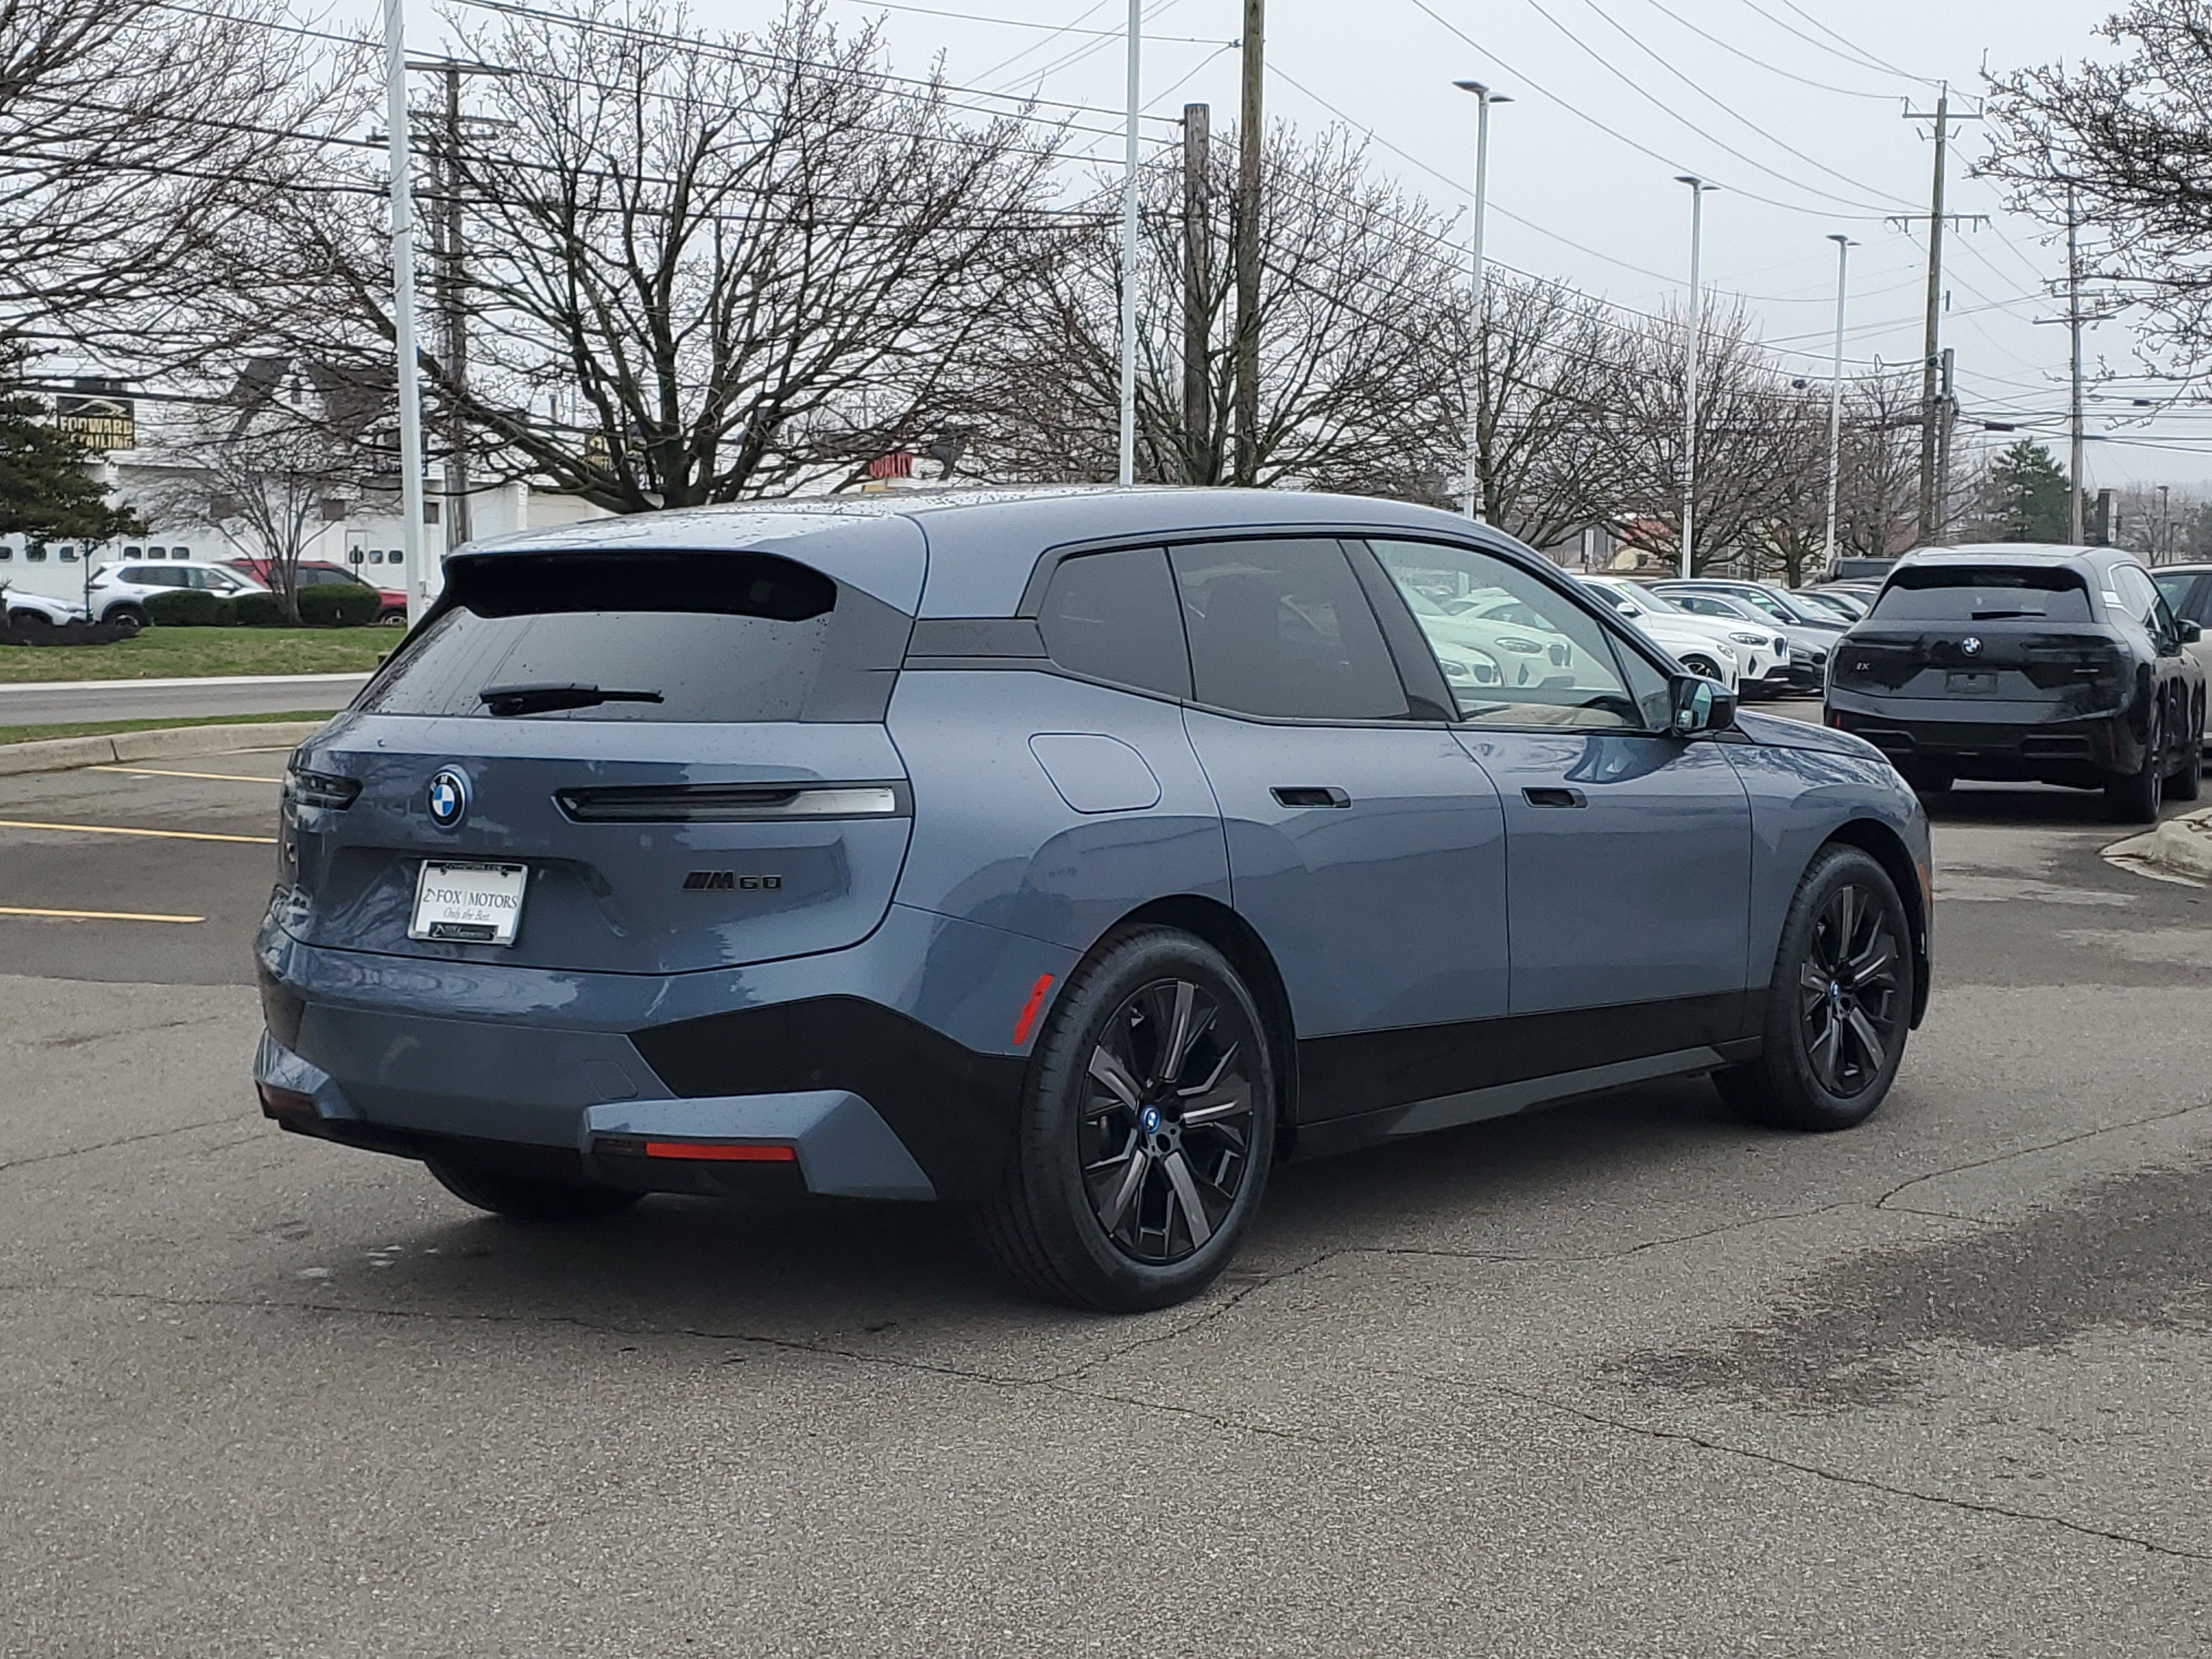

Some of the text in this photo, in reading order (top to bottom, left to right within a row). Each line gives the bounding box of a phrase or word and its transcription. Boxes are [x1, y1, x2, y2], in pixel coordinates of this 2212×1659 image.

[60, 416, 133, 435] FORWARD
[68, 433, 133, 449] ETAILING
[436, 889, 518, 909] FOX MOTORS
